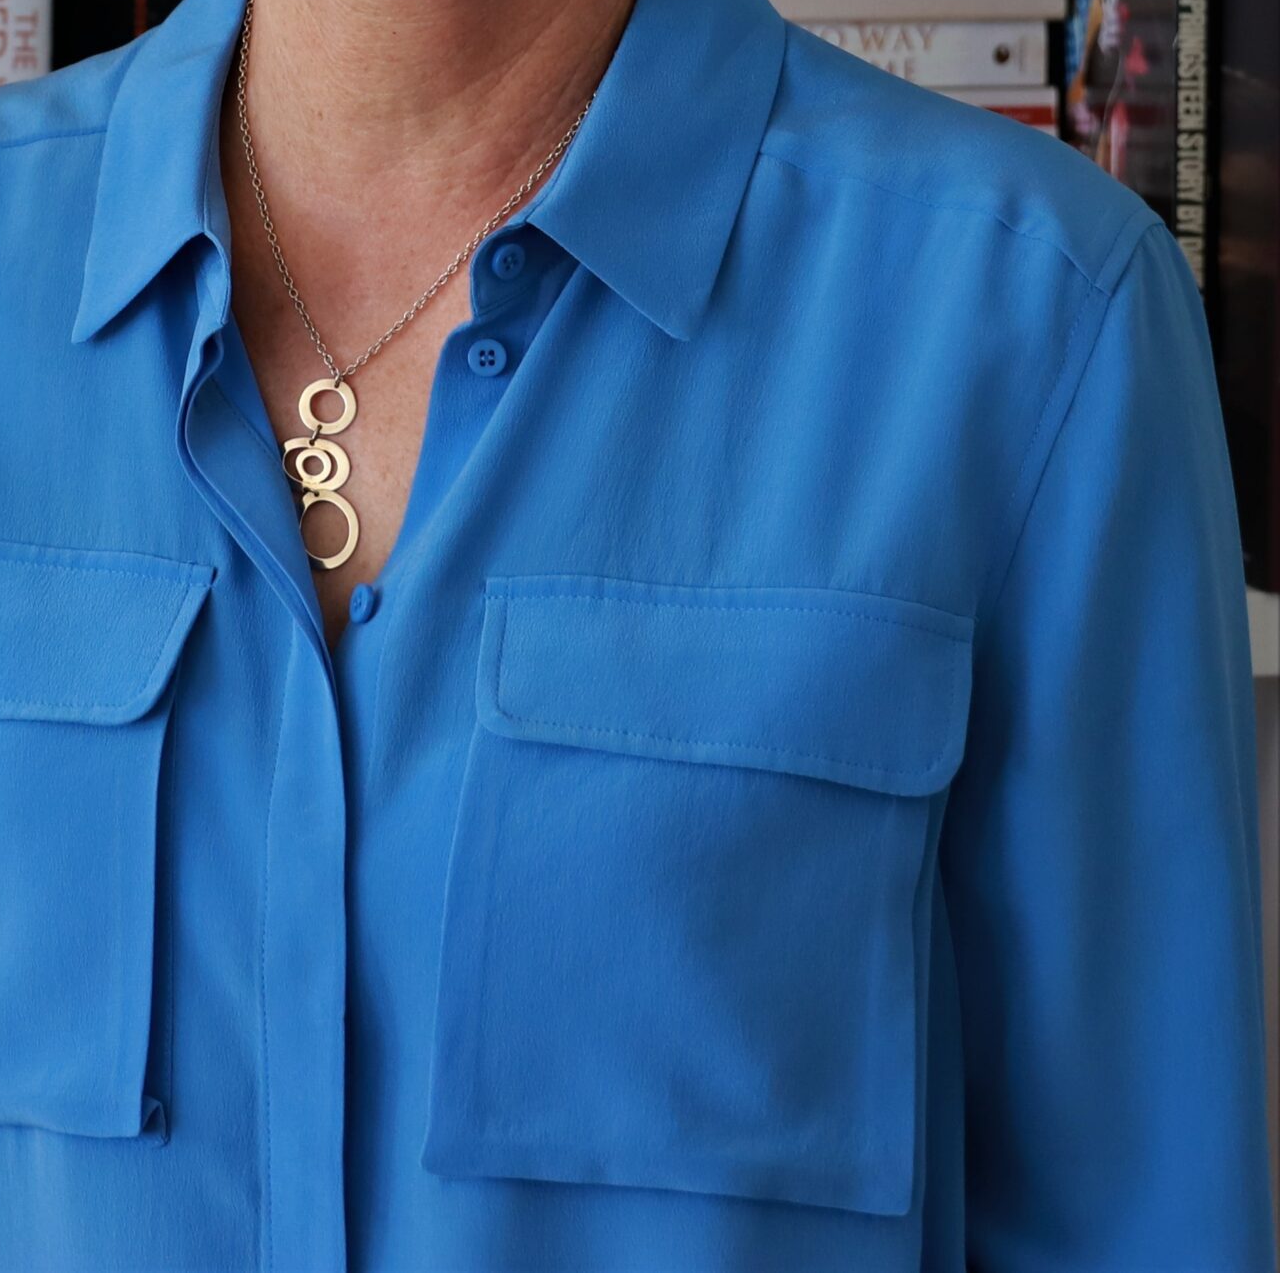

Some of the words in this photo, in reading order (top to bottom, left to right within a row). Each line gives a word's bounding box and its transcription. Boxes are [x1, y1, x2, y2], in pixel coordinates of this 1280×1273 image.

[11, 9, 40, 72] THE
[1175, 132, 1206, 203] STORY
[1174, 204, 1204, 235] BY
